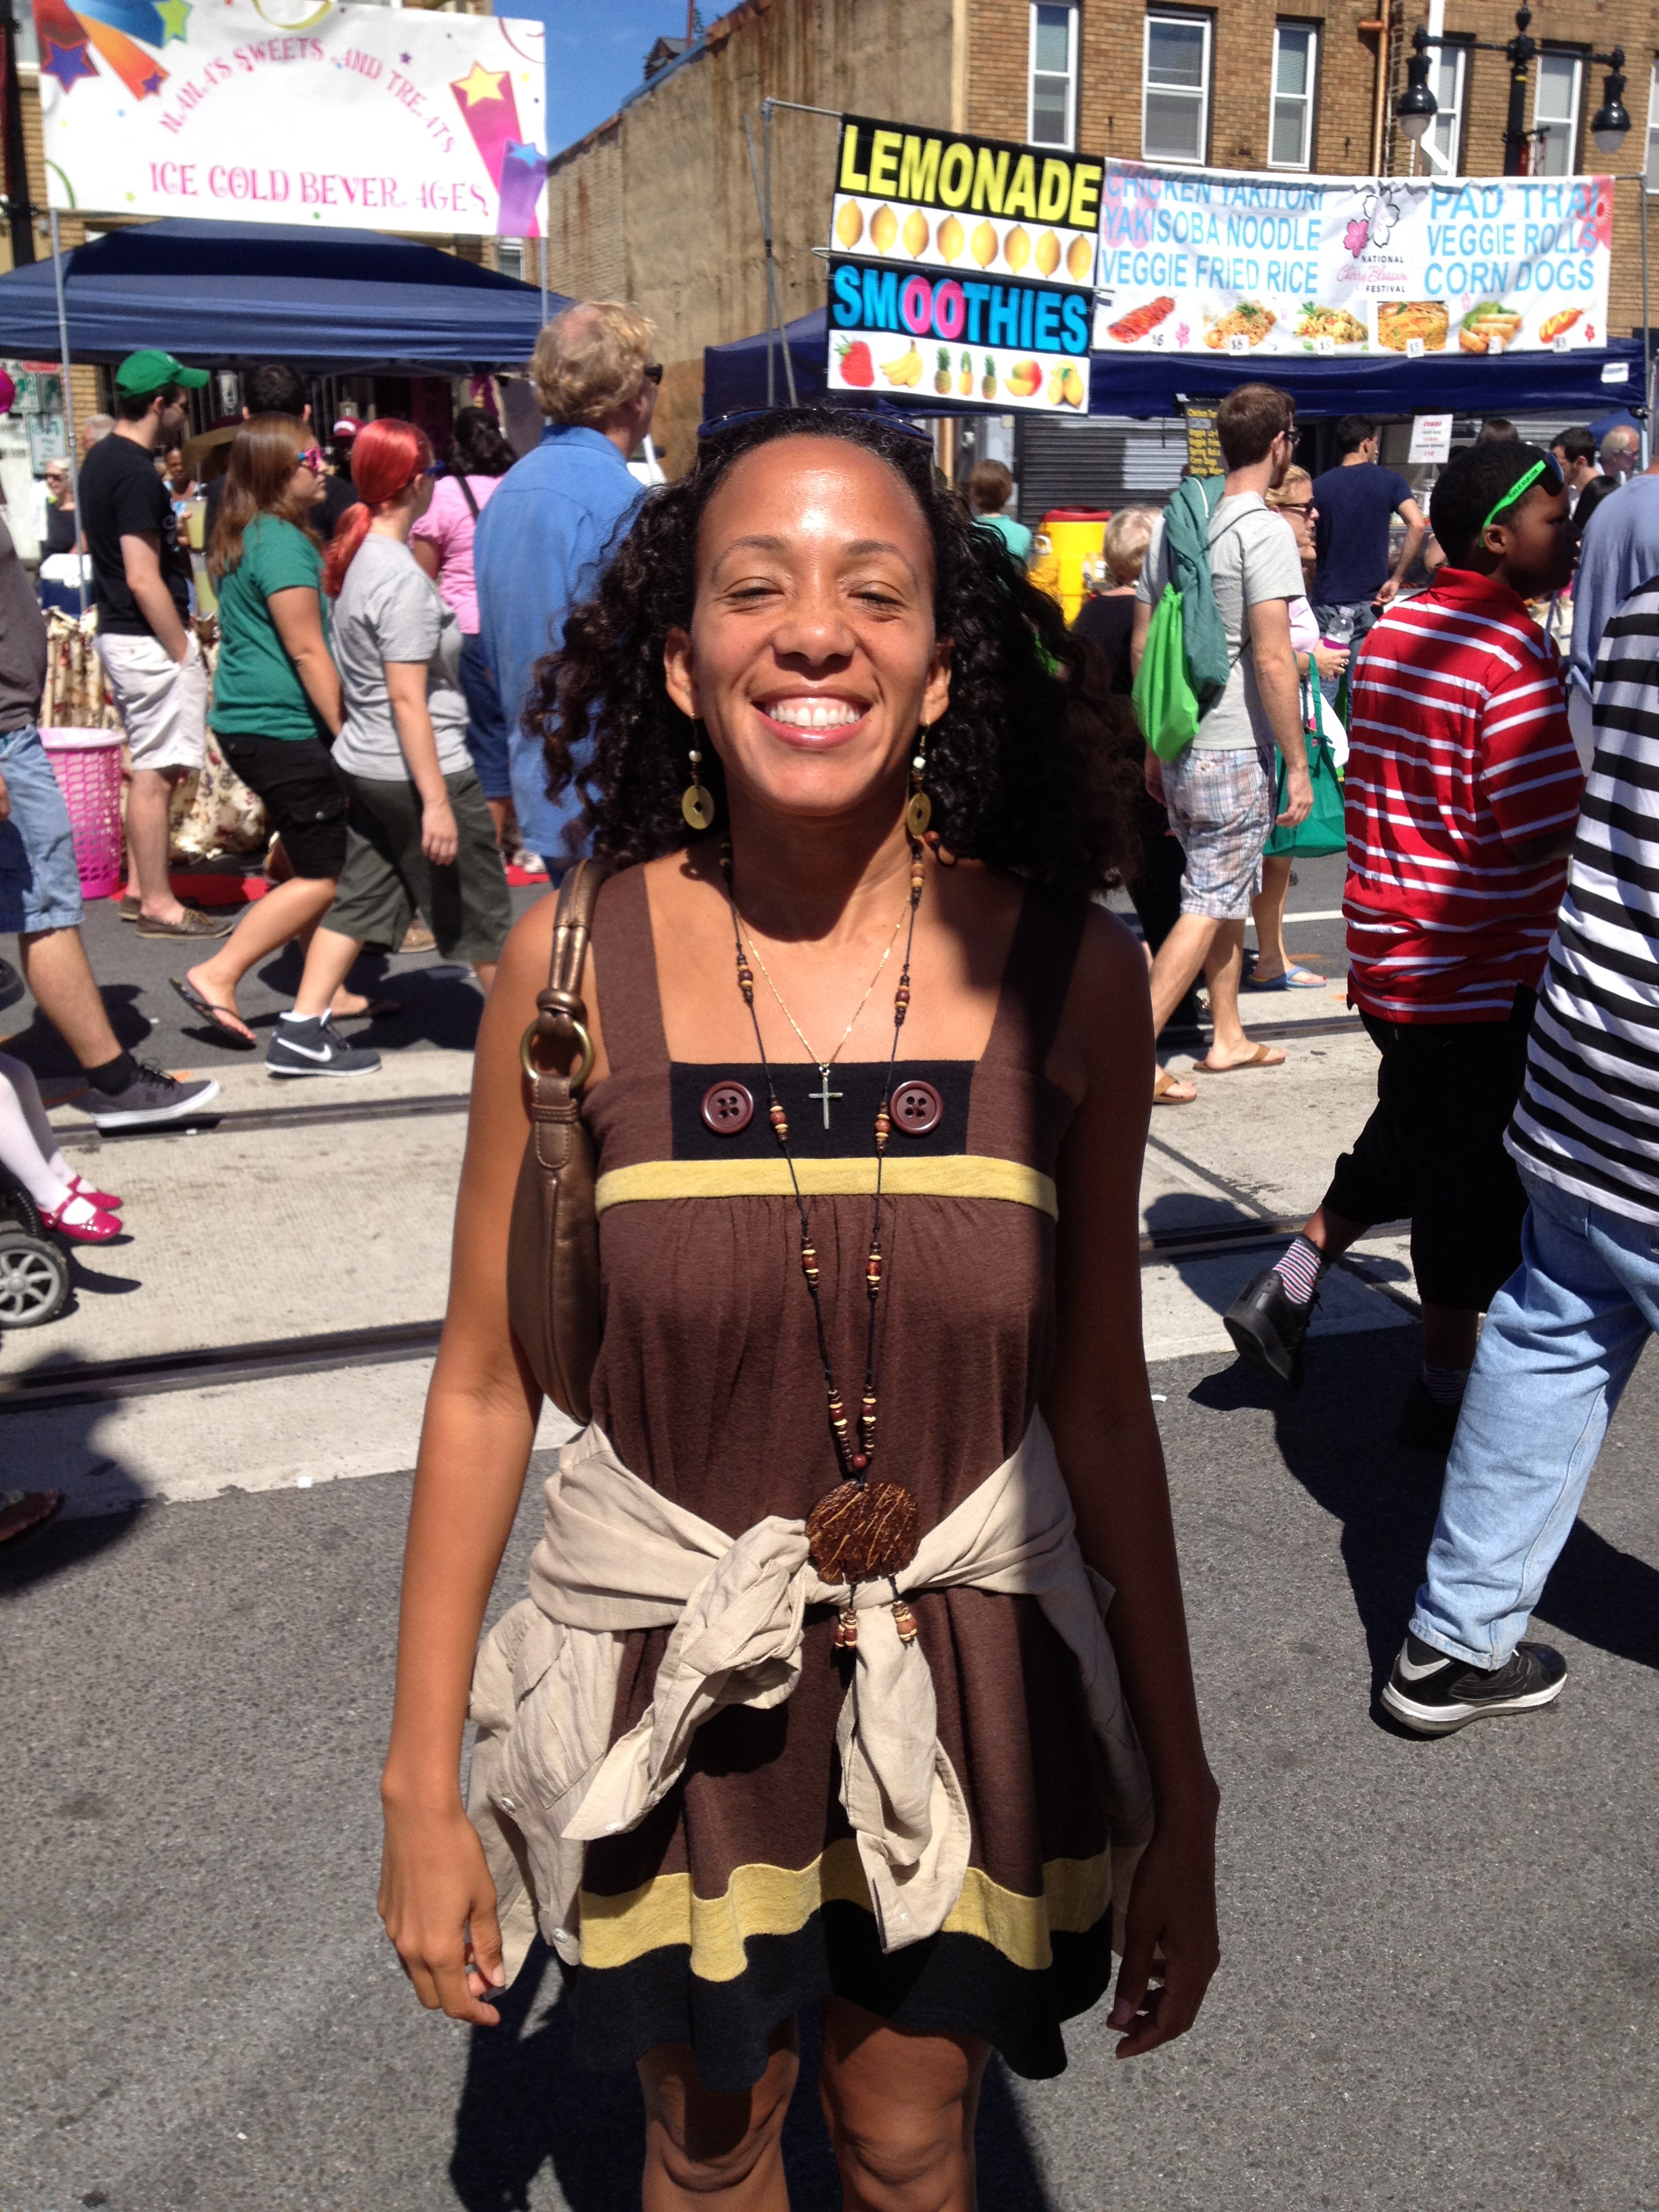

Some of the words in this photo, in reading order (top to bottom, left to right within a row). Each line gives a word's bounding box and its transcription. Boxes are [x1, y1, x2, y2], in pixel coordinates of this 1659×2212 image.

[232, 37, 325, 72] SWEETS
[331, 47, 383, 80] AND
[386, 69, 458, 153] TREATS
[149, 161, 198, 196] ICE
[207, 165, 291, 203] COLD
[840, 124, 1103, 228] LEMONADE
[1106, 165, 1212, 204] CHICKEN
[1429, 182, 1504, 220] PAD
[1517, 182, 1599, 219] THAI
[1104, 205, 1221, 246] YAKISOBA
[1227, 214, 1322, 252] NOODLE
[1427, 223, 1515, 257] VEGGIE
[1523, 222, 1597, 255] ROLLS
[1102, 249, 1187, 287] VEGGIE
[1195, 254, 1260, 290] FRIED
[1266, 259, 1319, 294] RICE
[1361, 255, 1404, 264] NATIONAL
[1424, 261, 1509, 295] CORN
[1515, 259, 1595, 292] DOGS
[1365, 285, 1406, 293] FESTIVAL
[833, 264, 1089, 355] SMOOTHIES
